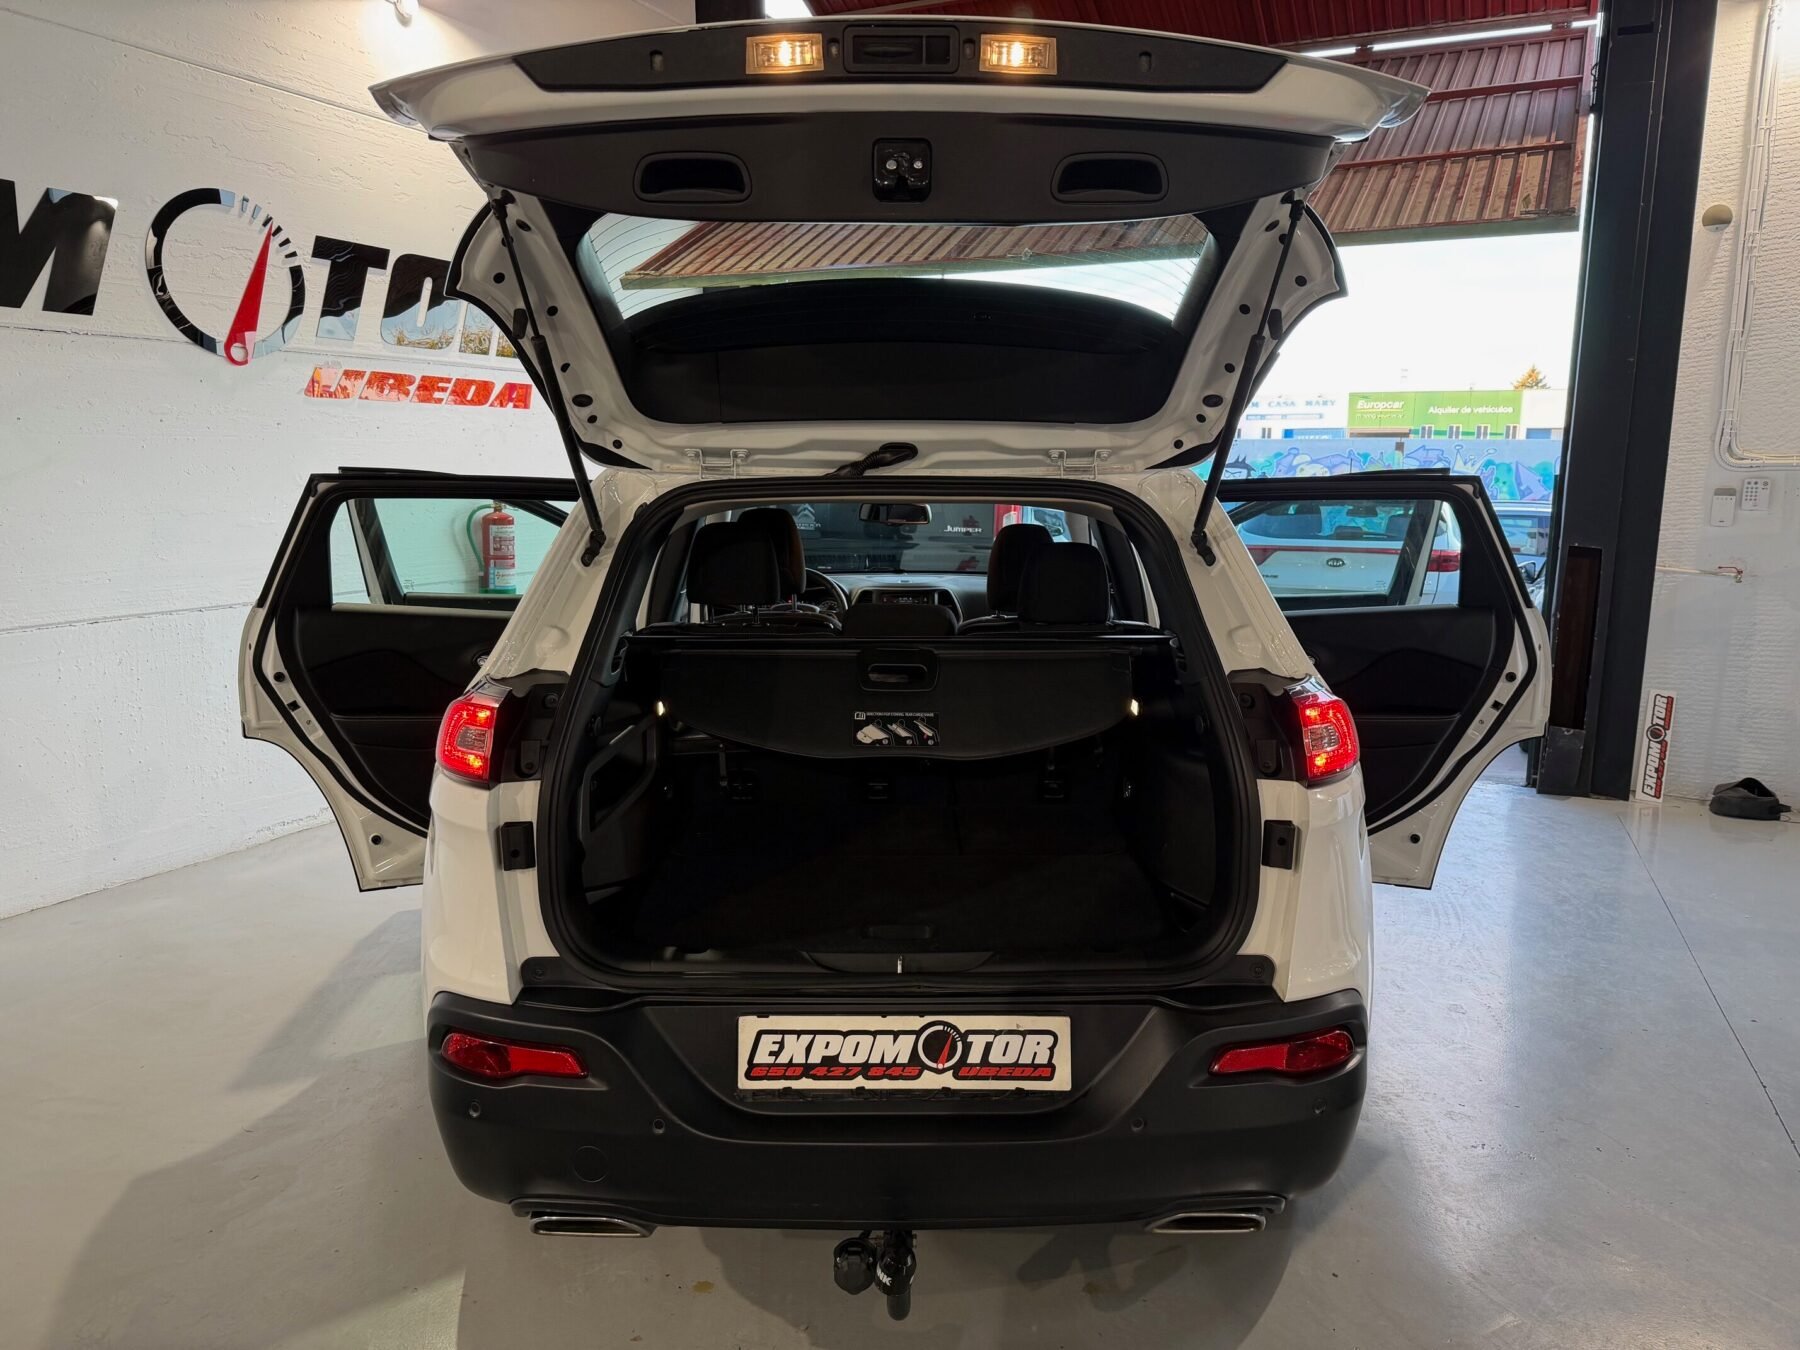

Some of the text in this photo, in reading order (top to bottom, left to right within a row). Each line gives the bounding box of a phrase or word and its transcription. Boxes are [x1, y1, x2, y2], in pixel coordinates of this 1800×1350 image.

[304, 366, 533, 410] UBEDA
[1356, 400, 1405, 411] Europcar
[1427, 405, 1460, 415] Alquiler
[1461, 405, 1472, 414] de
[809, 1066, 862, 1077] 427
[958, 1067, 1053, 1078] UBEDA
